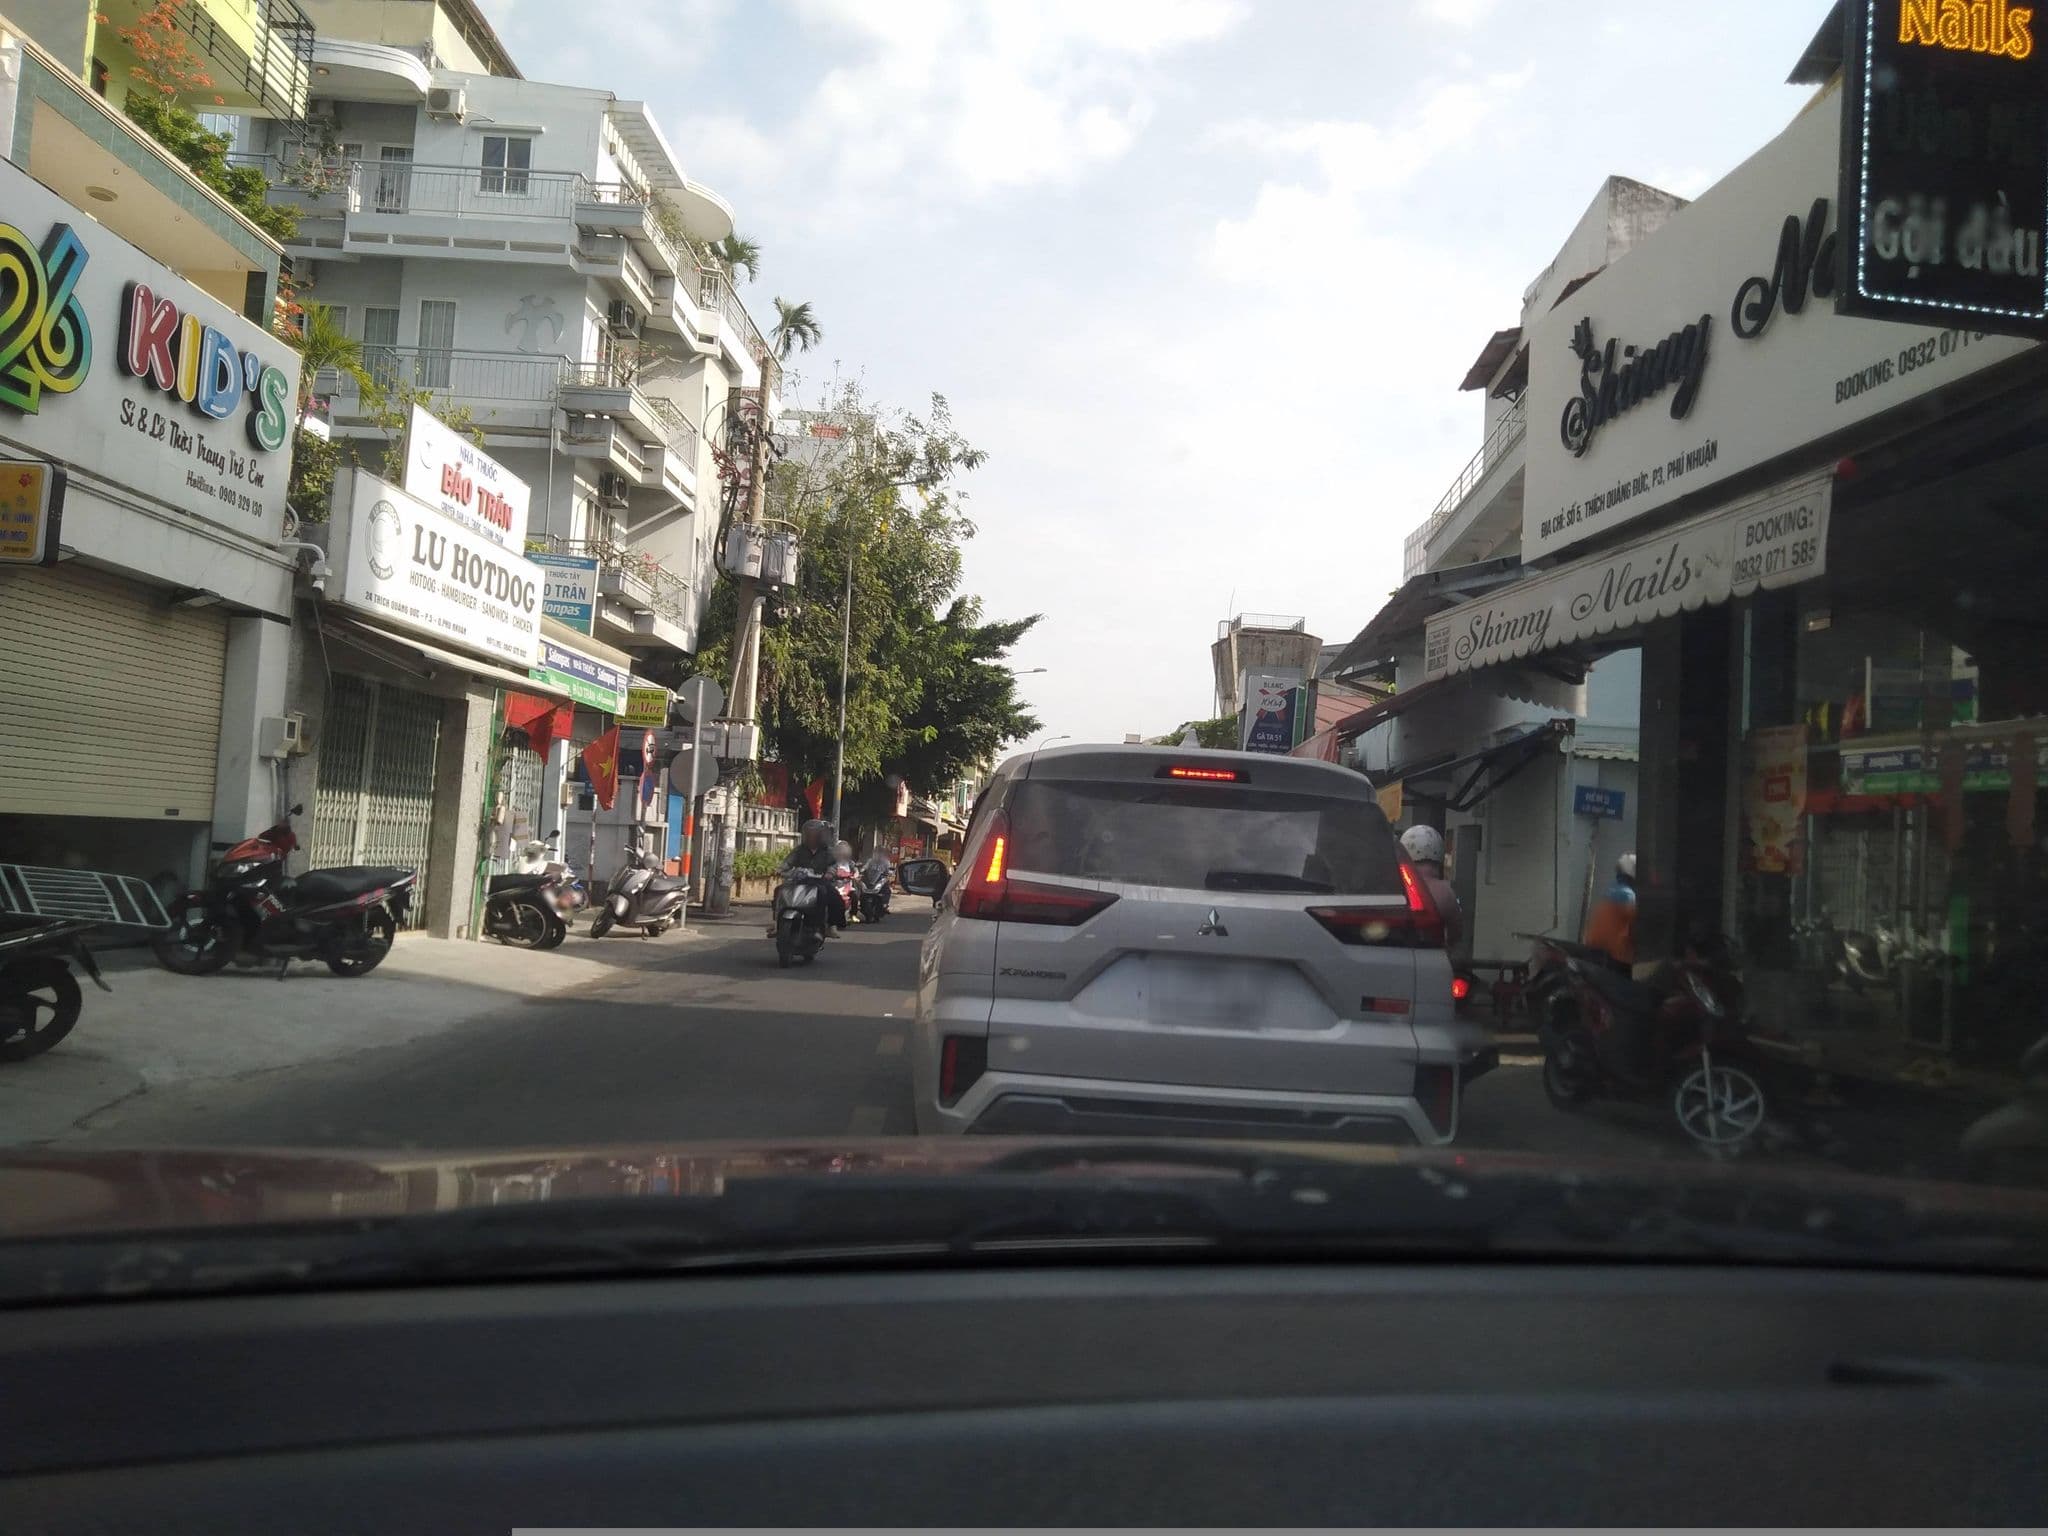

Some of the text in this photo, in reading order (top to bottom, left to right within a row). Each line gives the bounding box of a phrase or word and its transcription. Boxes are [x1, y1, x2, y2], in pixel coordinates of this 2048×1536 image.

[1898, 0, 2034, 58] Nails
[1873, 197, 1948, 279] Gội
[120, 280, 289, 453] KID'S
[1561, 314, 1713, 458] Shinny
[1835, 356, 1895, 404] BOOKING:
[1898, 343, 1936, 376] 0932
[137, 408, 148, 434] &
[197, 433, 226, 476] Trang
[248, 458, 265, 488] Em
[1585, 489, 1606, 518] THÍCH
[1606, 480, 1632, 509] QUẢNG
[1667, 451, 1685, 482] PHÚ
[1686, 438, 1718, 473] NHUẬN
[218, 485, 237, 507] 0903
[237, 493, 251, 513] 329
[251, 503, 263, 518] 130
[441, 461, 473, 506] BẢO
[1745, 506, 1814, 548] BOOKING:
[1765, 544, 1787, 573] 071
[1791, 537, 1817, 566] 585
[412, 524, 447, 571] LU
[451, 543, 535, 614] HOTDOG
[555, 582, 587, 600] TRÂN
[410, 570, 533, 633] HOTDOG HAMBURGER SANDWICH CHICKEN
[543, 600, 581, 617] lonpas
[1455, 605, 1554, 661] Shinny
[1571, 541, 1692, 621] Nails
